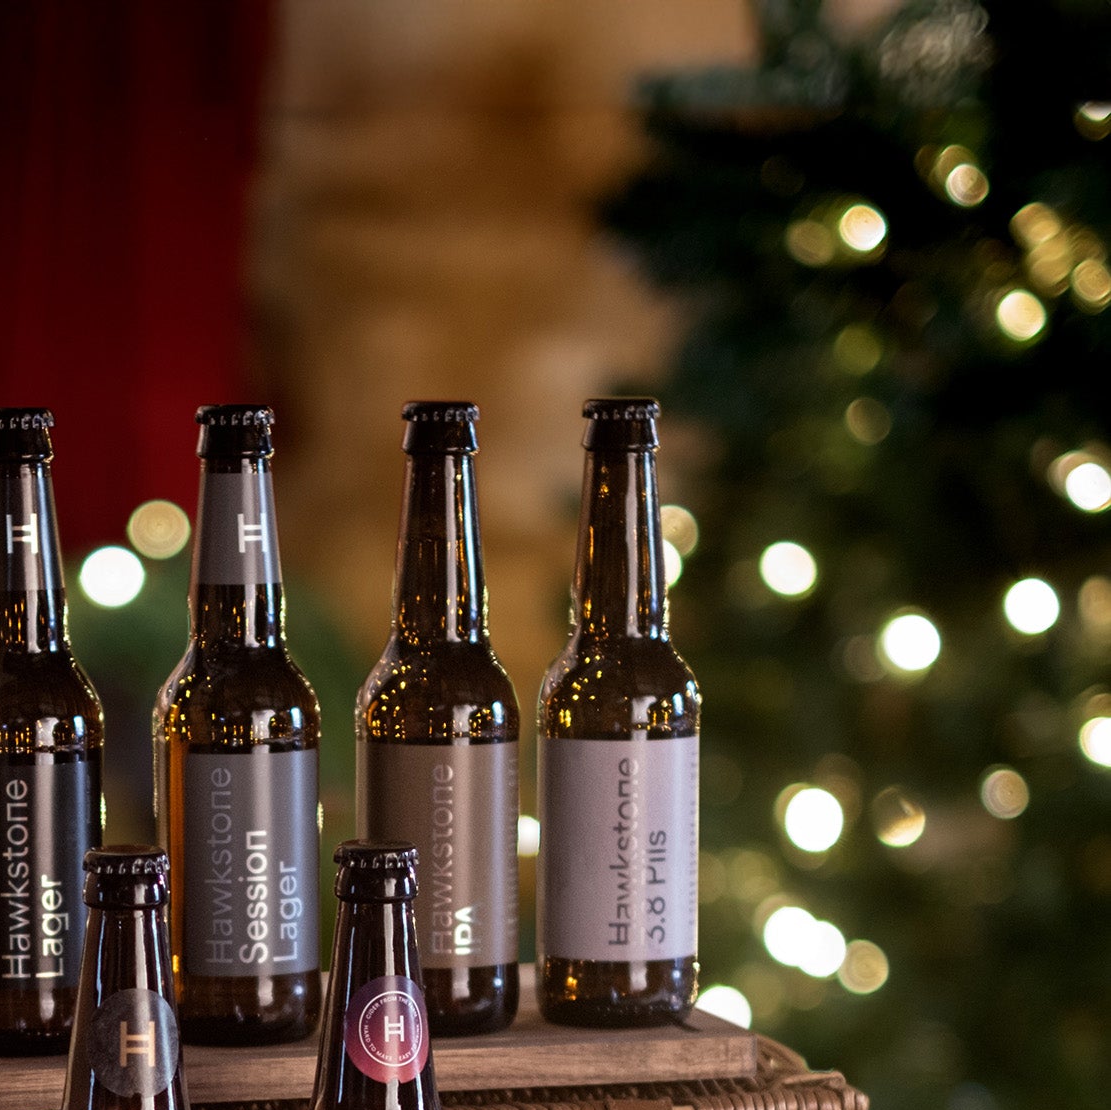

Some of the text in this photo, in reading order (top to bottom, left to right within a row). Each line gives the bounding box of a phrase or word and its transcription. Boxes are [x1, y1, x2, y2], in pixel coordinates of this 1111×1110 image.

[0, 778, 31, 979] Hawkstone
[35, 874, 69, 979] Lager
[204, 767, 233, 964] Hawkstone
[238, 829, 269, 964] Session
[272, 861, 303, 962] Lager
[431, 763, 454, 956] Hawkstone
[608, 757, 639, 946] Hawkstone
